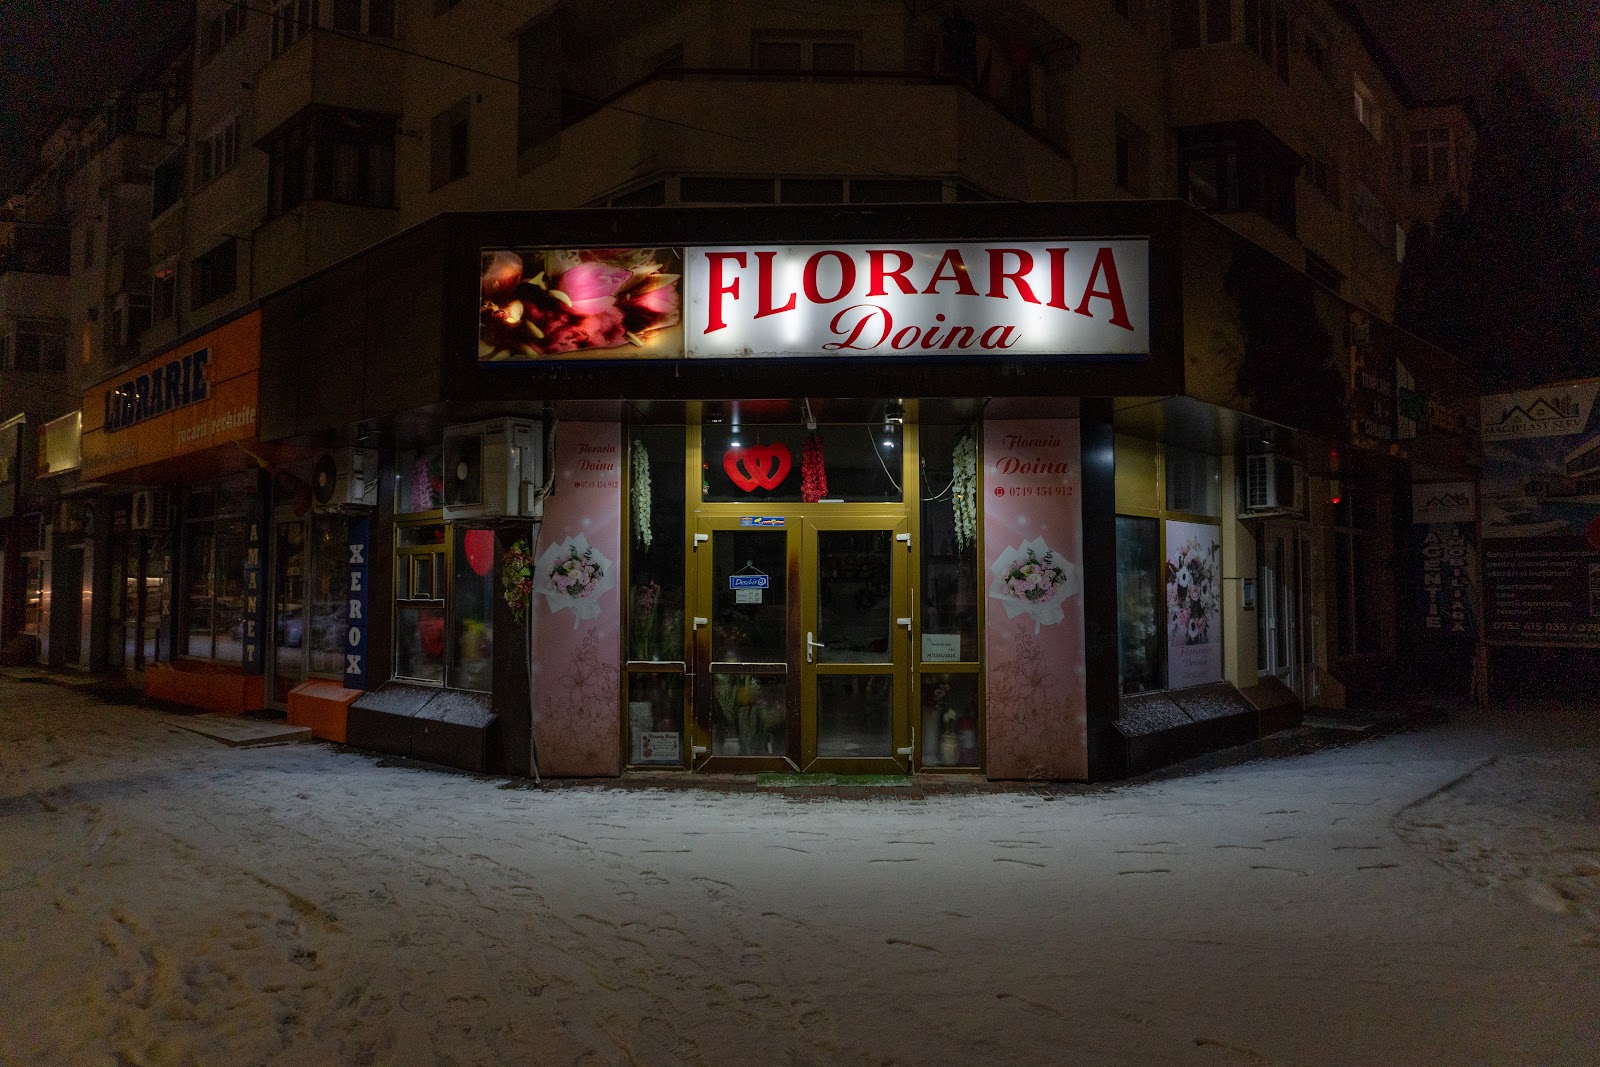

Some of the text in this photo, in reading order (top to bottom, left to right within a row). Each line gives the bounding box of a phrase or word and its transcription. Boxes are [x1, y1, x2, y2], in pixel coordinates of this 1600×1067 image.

[703, 246, 1135, 335] FLORARIA
[821, 303, 1022, 351] Doina
[576, 443, 616, 455] Floraria
[1002, 435, 1061, 450] Floraria
[577, 459, 614, 471] Doina
[996, 456, 1070, 475] Doina
[246, 523, 260, 663] AMANET
[345, 543, 365, 675] XEROX
